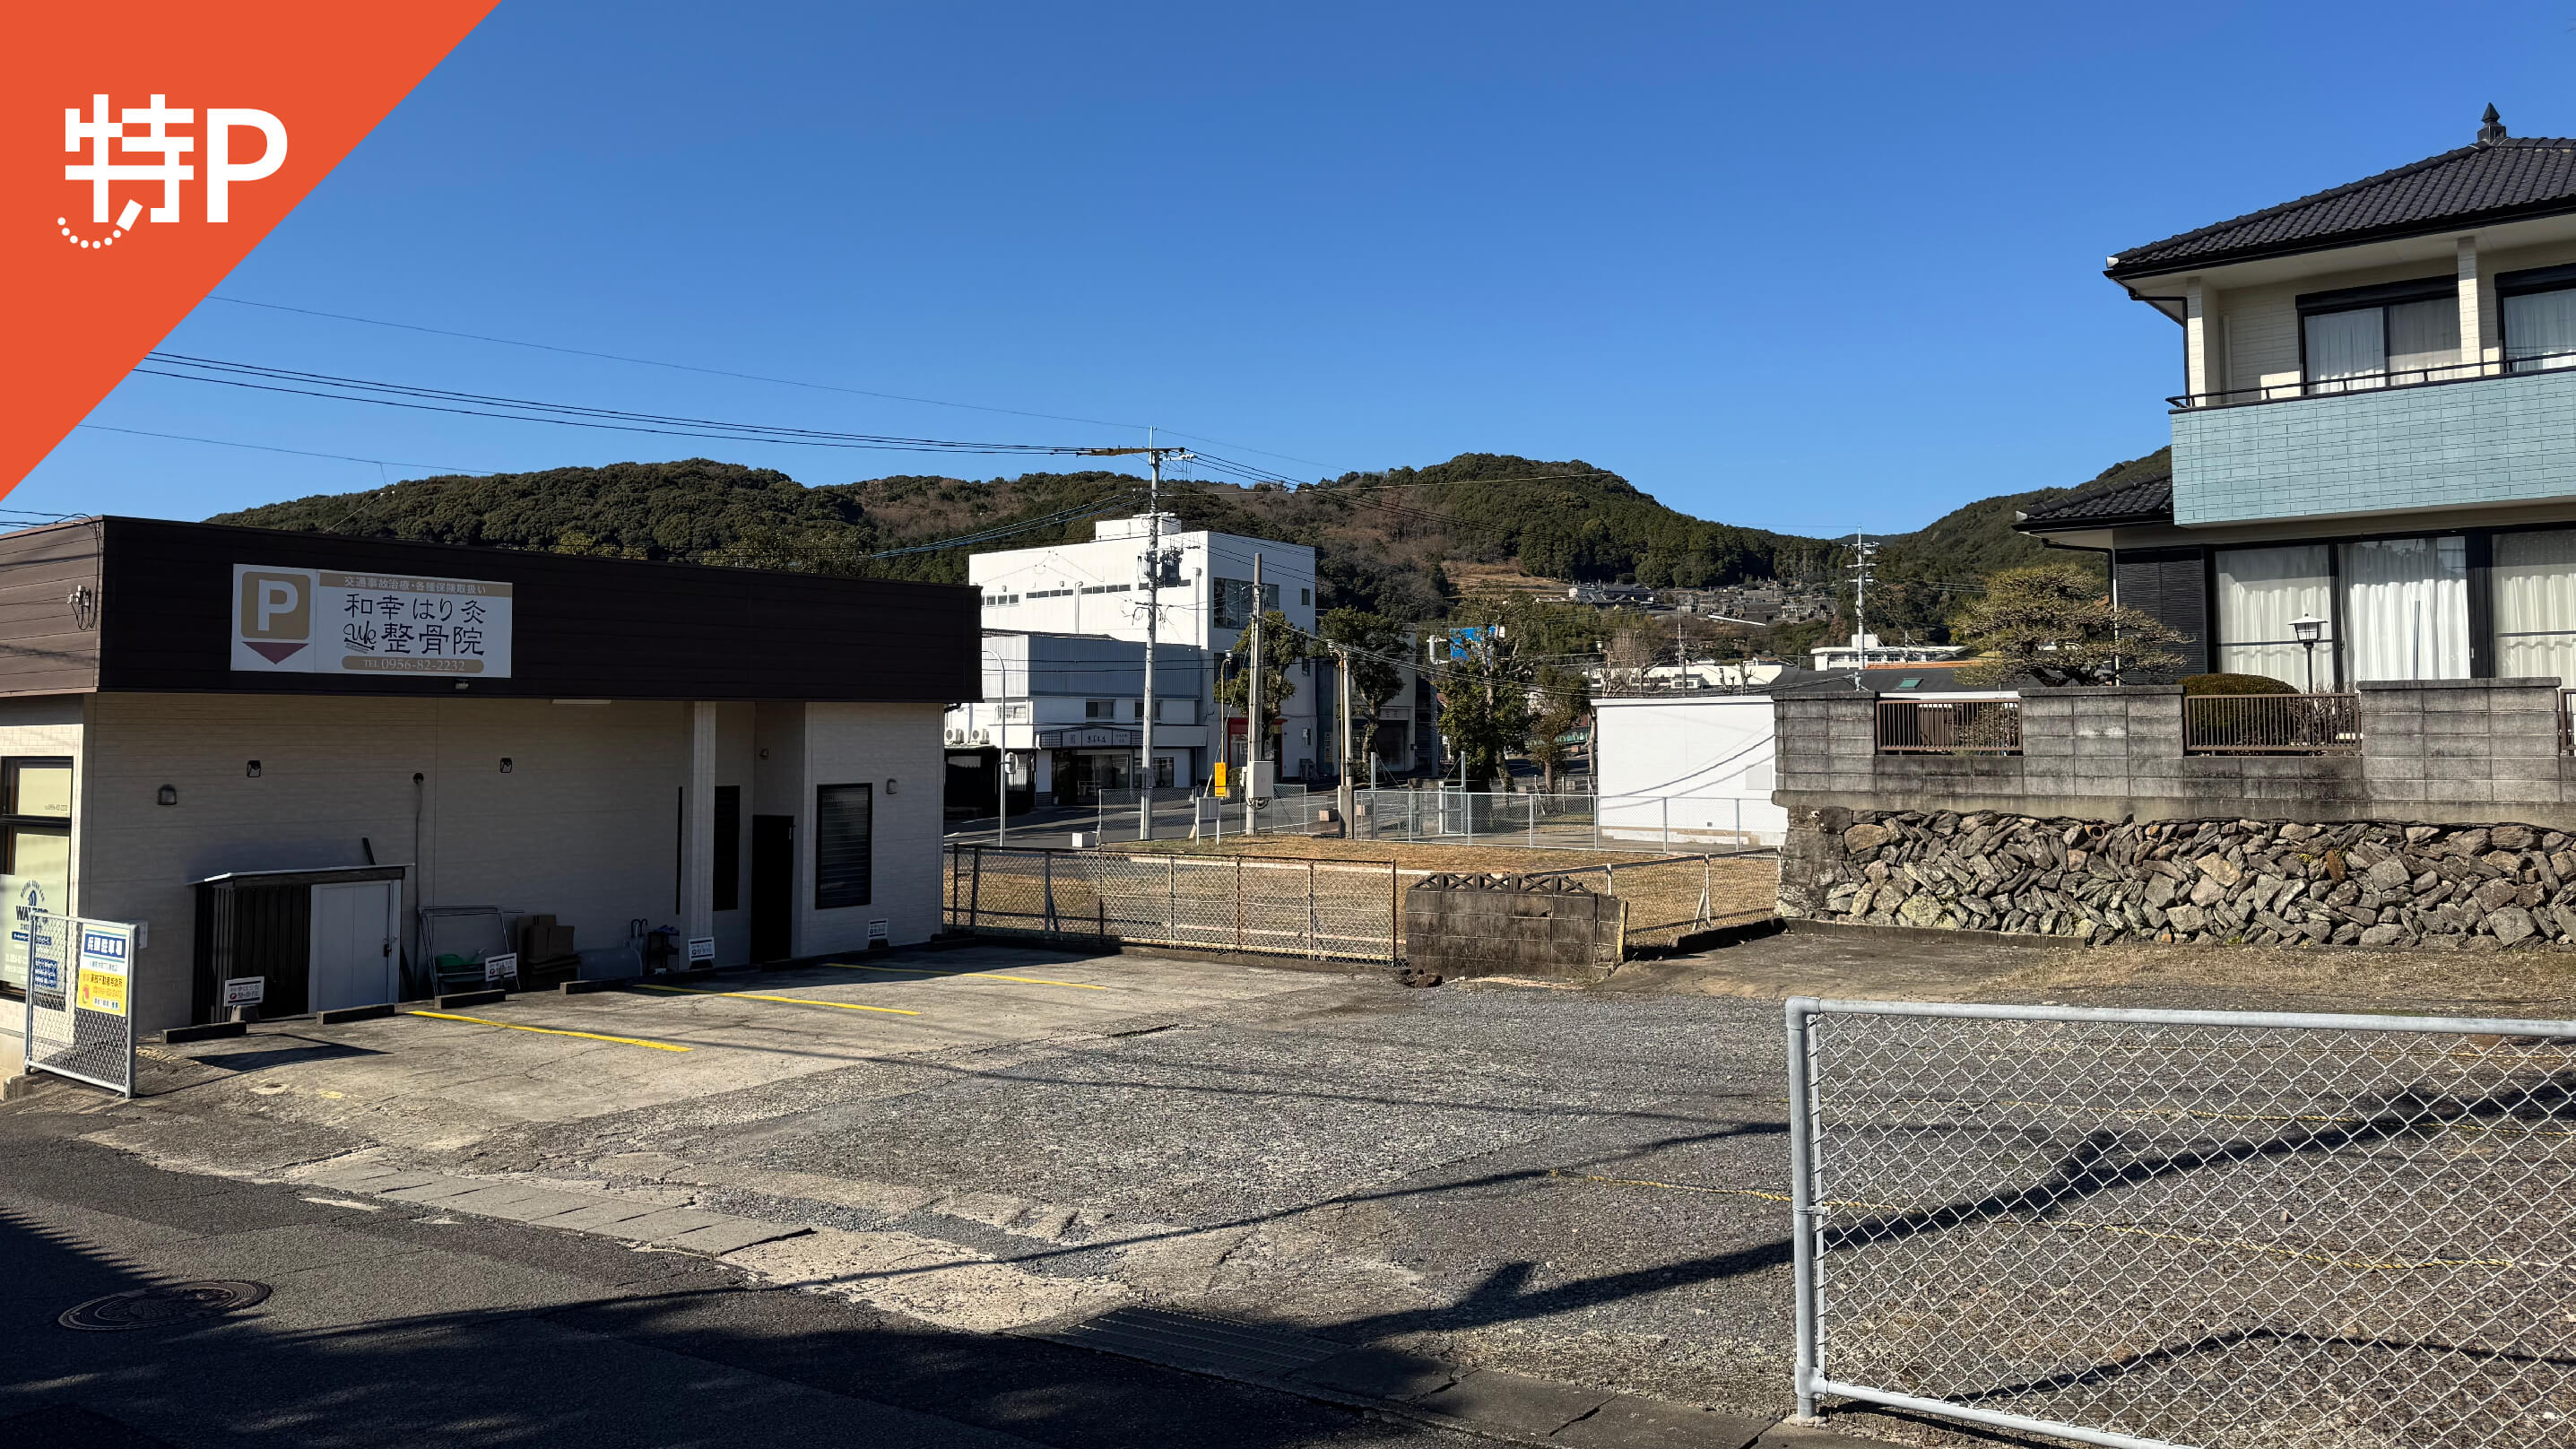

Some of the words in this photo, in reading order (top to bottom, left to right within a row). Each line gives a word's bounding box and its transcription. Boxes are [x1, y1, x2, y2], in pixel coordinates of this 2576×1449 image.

[257, 579, 299, 631] P
[344, 594, 487, 624] 和幸はり灸
[381, 622, 485, 655] 整骨院
[381, 658, 465, 672] 0956-82-2232
